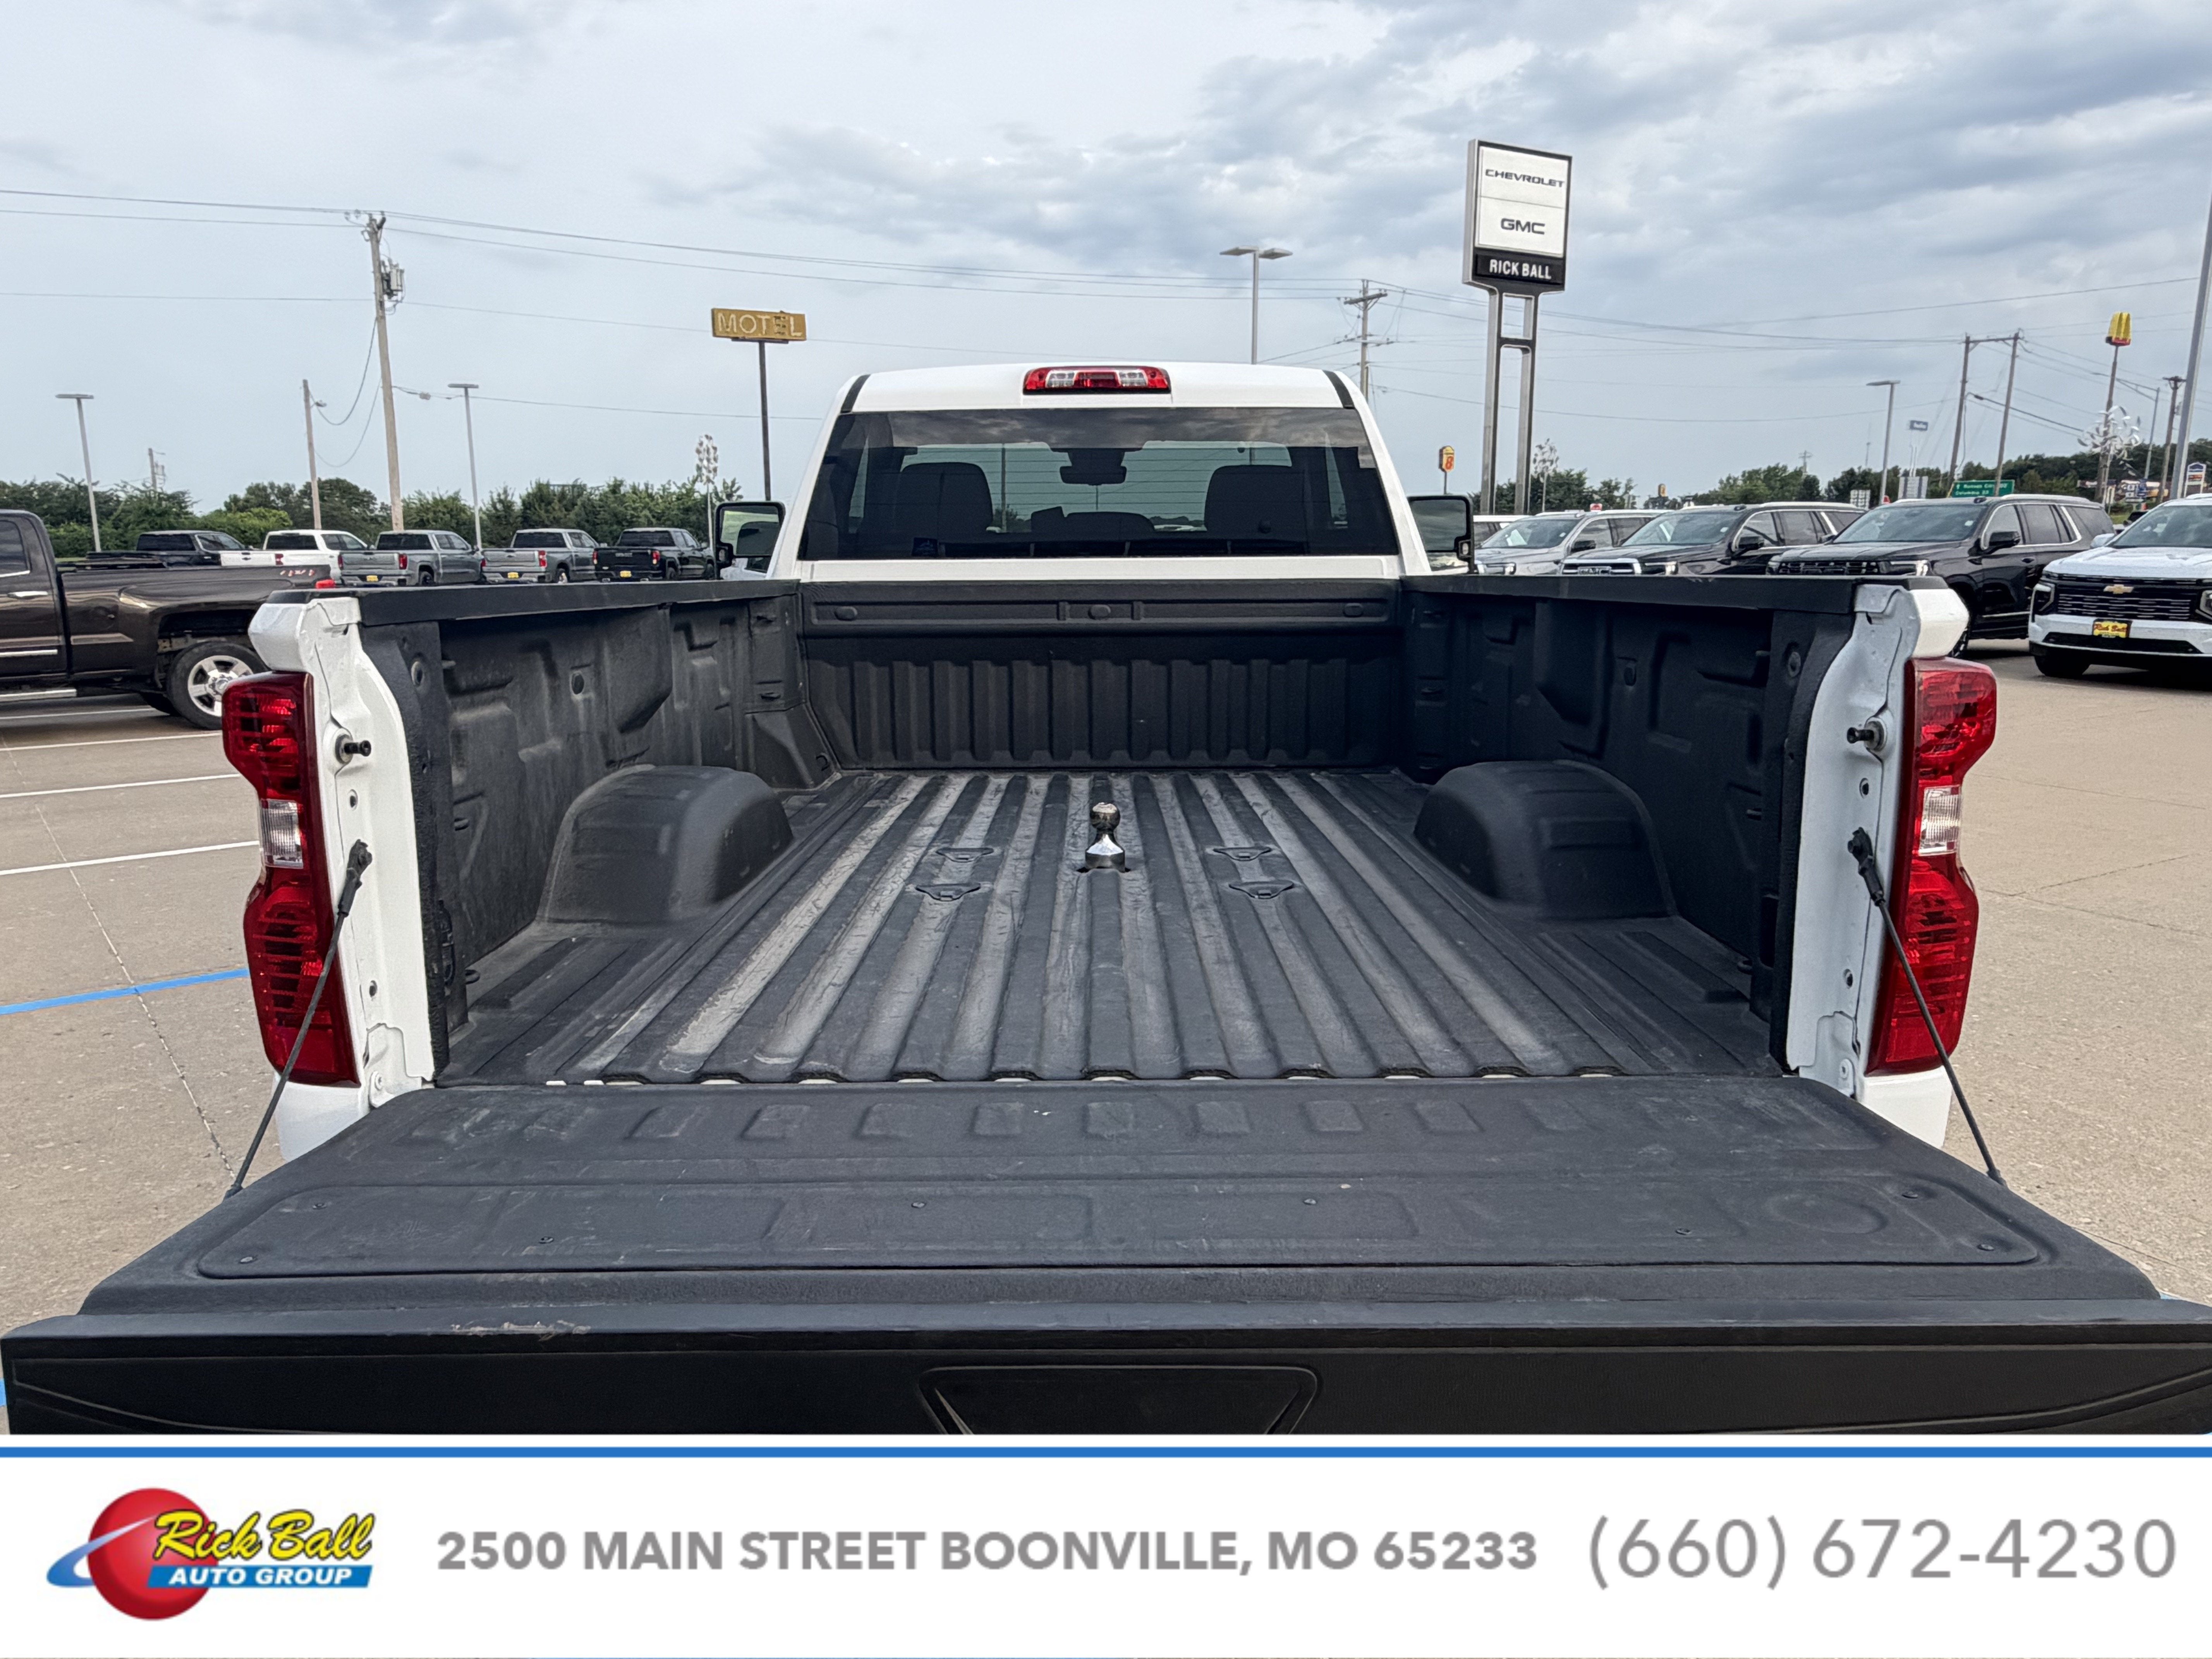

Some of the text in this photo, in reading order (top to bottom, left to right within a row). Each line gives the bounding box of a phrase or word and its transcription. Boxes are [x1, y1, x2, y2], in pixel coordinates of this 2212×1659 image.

[1485, 168, 1565, 187] CHEVROLET
[1501, 218, 1546, 235] GMC
[1489, 259, 1551, 280] RICK BALL
